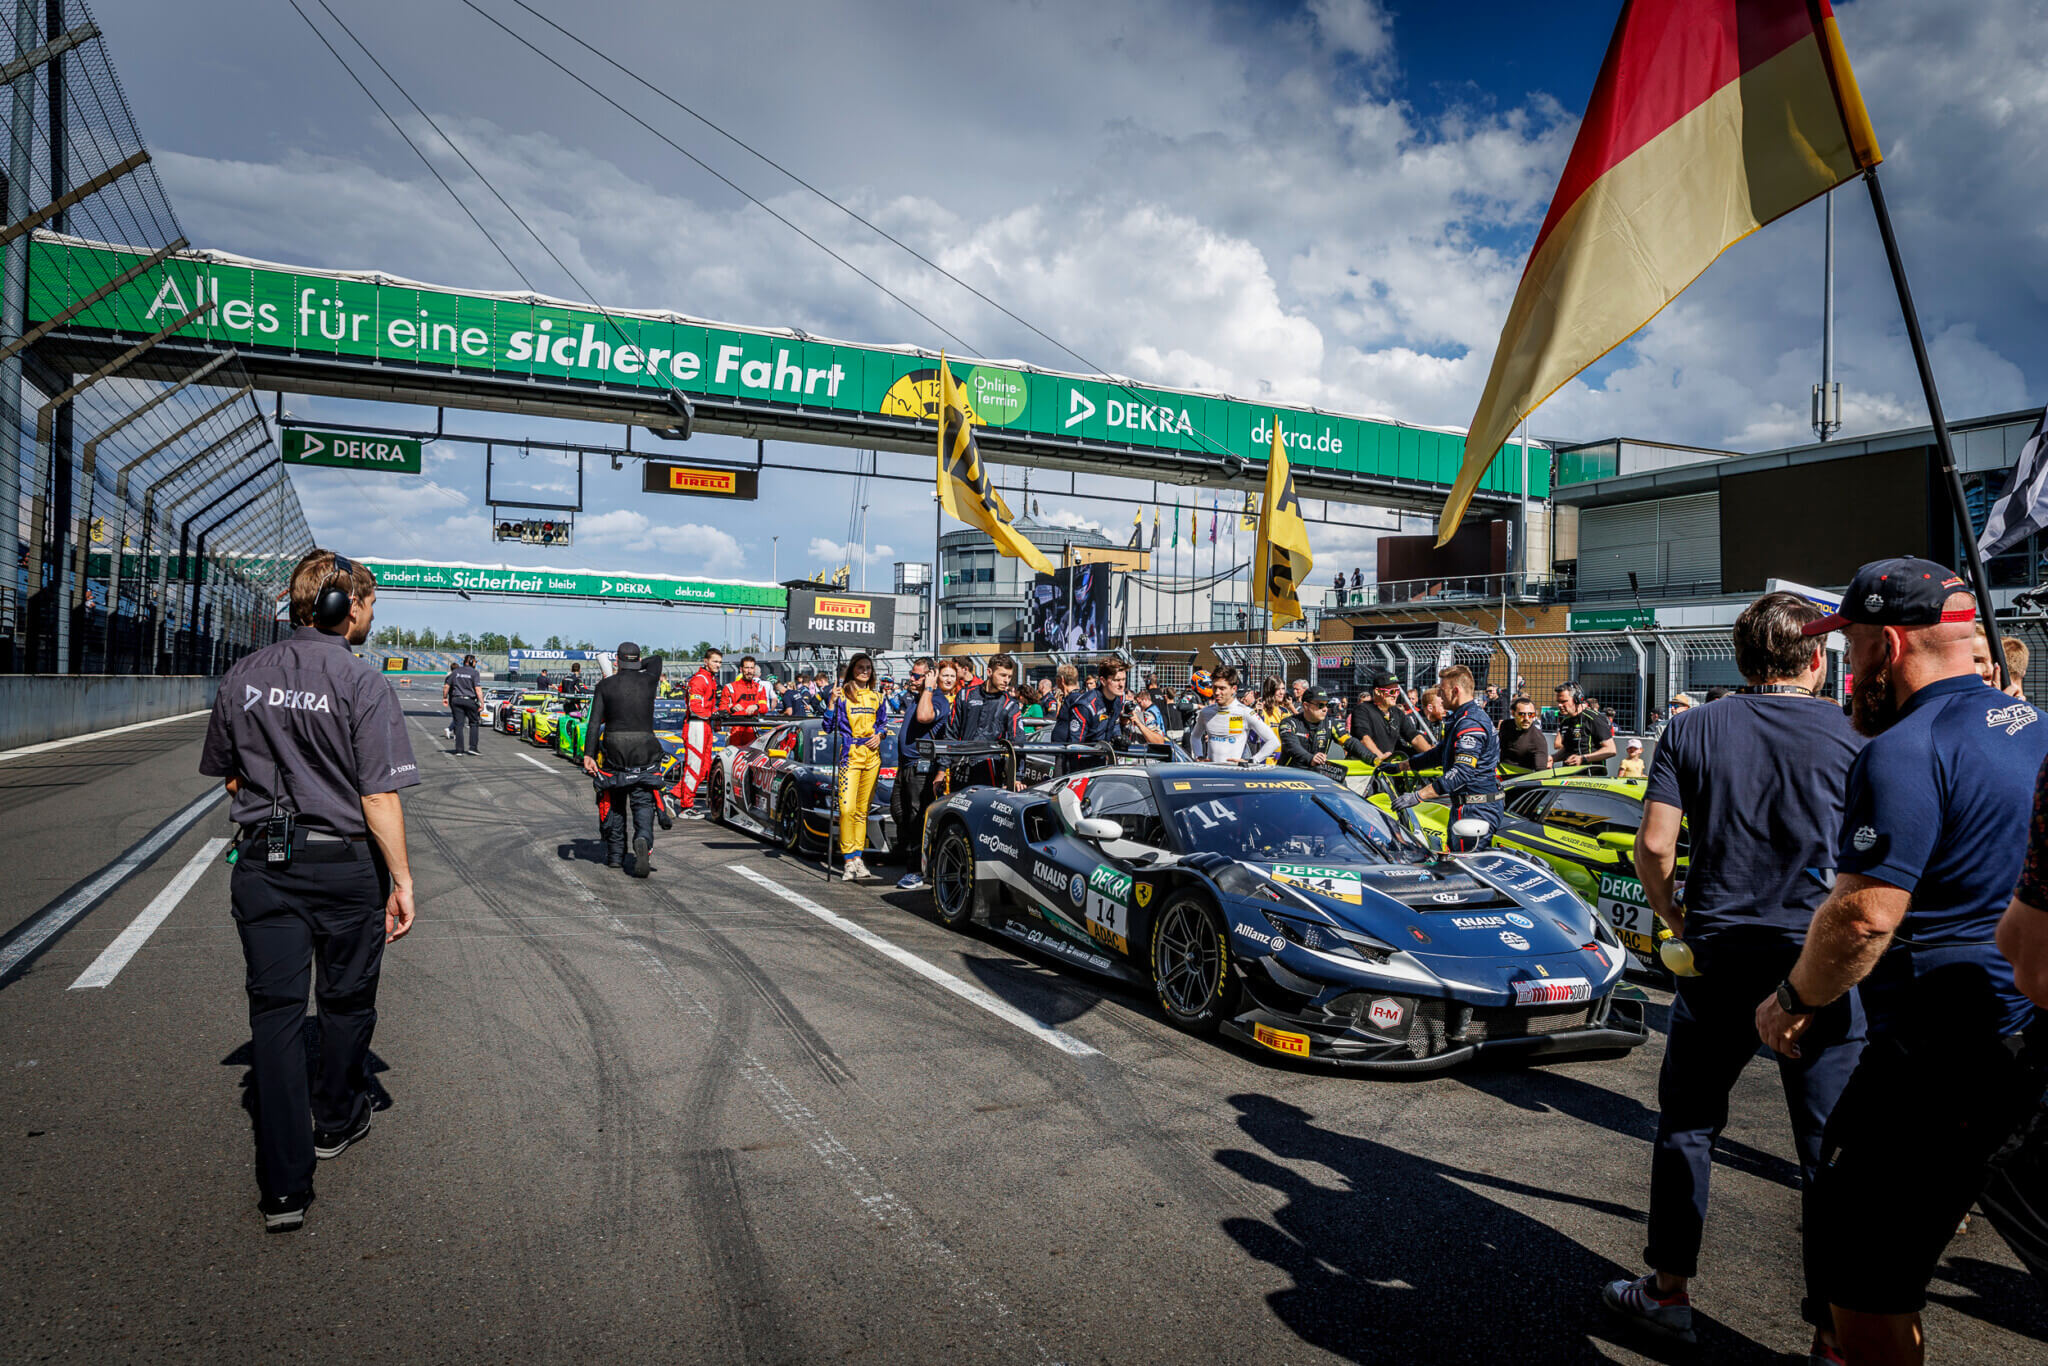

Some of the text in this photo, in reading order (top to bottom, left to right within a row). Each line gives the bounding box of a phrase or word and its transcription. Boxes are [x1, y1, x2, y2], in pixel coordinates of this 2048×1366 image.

[145, 274, 845, 398] Alles für eine sichere Fahrt
[974, 376, 1022, 394] Online-
[976, 391, 1018, 408] Termin
[1107, 399, 1194, 436] DEKRA
[1251, 417, 1343, 454] dekra.de
[333, 440, 406, 463] DEKRA
[676, 472, 730, 489] PIRELLI
[383, 570, 420, 582] ändert
[423, 570, 447, 585] sich,
[451, 571, 544, 592] Sicherheit
[548, 579, 577, 591] bleibt
[616, 582, 653, 595] DEKRA
[674, 586, 716, 598] dekra.de
[819, 600, 867, 615] PIRELLI
[807, 617, 876, 635] POLE SETTER
[522, 650, 568, 659] VIEROL
[268, 687, 330, 713] DEKRA
[397, 763, 417, 774] DEKRA
[1188, 799, 1238, 830] 14
[1033, 860, 1067, 891] KNAUS
[1275, 865, 1359, 880] DEKRA
[1089, 868, 1132, 903] DEKRA
[1288, 879, 1343, 900] ADAC
[1096, 898, 1116, 929] 14
[1451, 916, 1507, 927] KNAUS
[1612, 903, 1639, 931] 92
[1094, 922, 1121, 949] ADAC
[1234, 922, 1271, 944] Allianz
[1217, 933, 1228, 998] PIRELLI
[1374, 1006, 1400, 1021] R-M
[1258, 1028, 1304, 1052] PIRELLI
